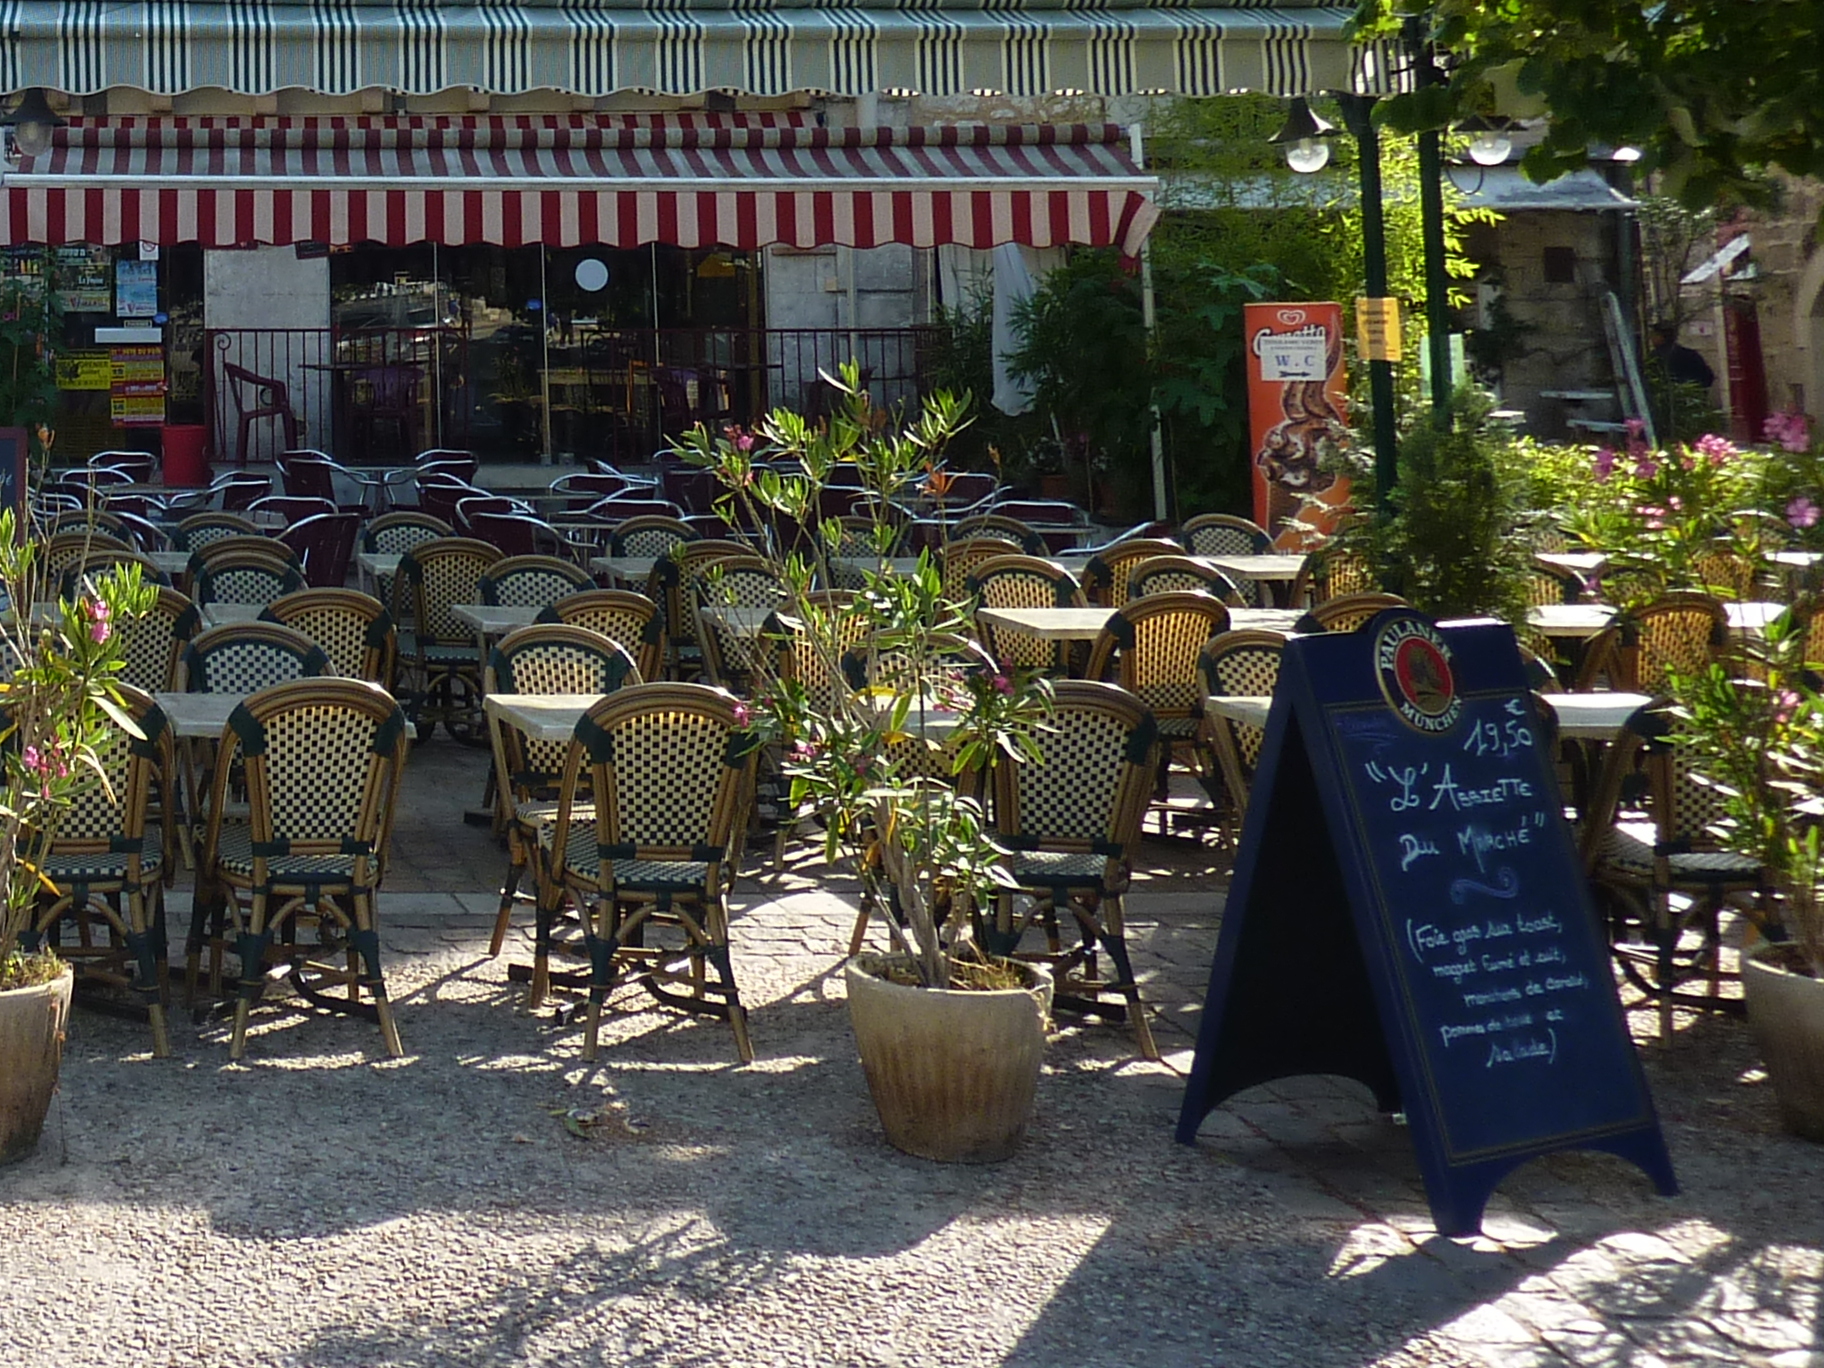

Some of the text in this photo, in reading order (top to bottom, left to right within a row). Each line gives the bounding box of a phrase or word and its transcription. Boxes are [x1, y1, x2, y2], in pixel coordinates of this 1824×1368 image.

[1379, 619, 1453, 671] PAULANER
[1463, 718, 1533, 757] 19,50
[1525, 979, 1545, 996] de
